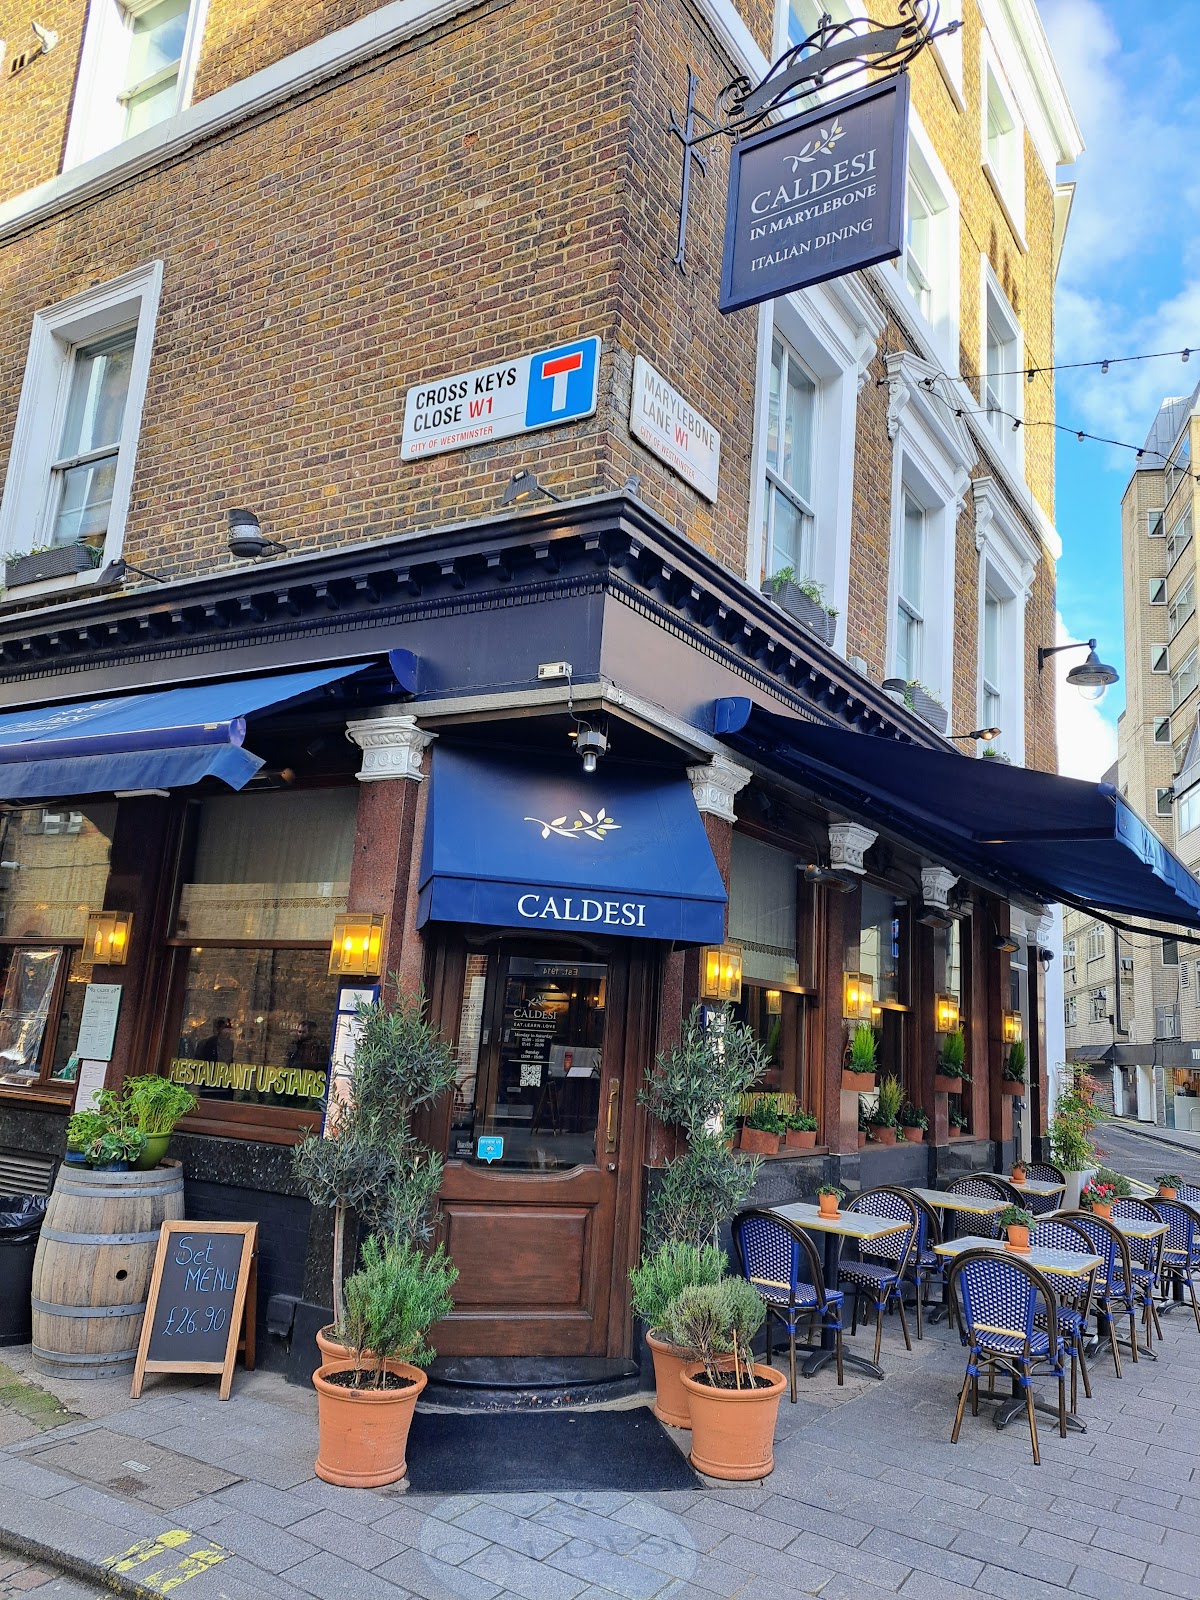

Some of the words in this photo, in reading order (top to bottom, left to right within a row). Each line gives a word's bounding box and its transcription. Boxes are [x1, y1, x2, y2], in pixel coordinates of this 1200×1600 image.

[751, 149, 877, 214] CALDESI
[750, 226, 767, 241] IN
[769, 184, 877, 234] MARYLEBONE
[751, 240, 811, 271] ITALIAN
[814, 218, 873, 250] DINING
[416, 380, 468, 410] CROSS
[474, 367, 517, 395] KEYS
[413, 404, 463, 432] CLOSE
[468, 396, 494, 419] W1
[642, 394, 671, 436] LANE
[674, 423, 689, 452] W1
[644, 370, 715, 453] MARYLEBONE
[410, 441, 427, 453] CITY
[428, 438, 438, 449] OF
[440, 425, 493, 446] WESTMINSTER
[640, 425, 652, 442] CITY
[653, 438, 661, 448] OF
[661, 444, 696, 480] WESTMINSTER
[517, 894, 646, 927] CALDESI
[513, 1009, 557, 1020] CALDESI
[169, 1057, 256, 1091] RESTAURANT
[255, 1065, 326, 1099] UPSTAIRS
[175, 1236, 214, 1265] Set
[184, 1266, 236, 1292] MENU
